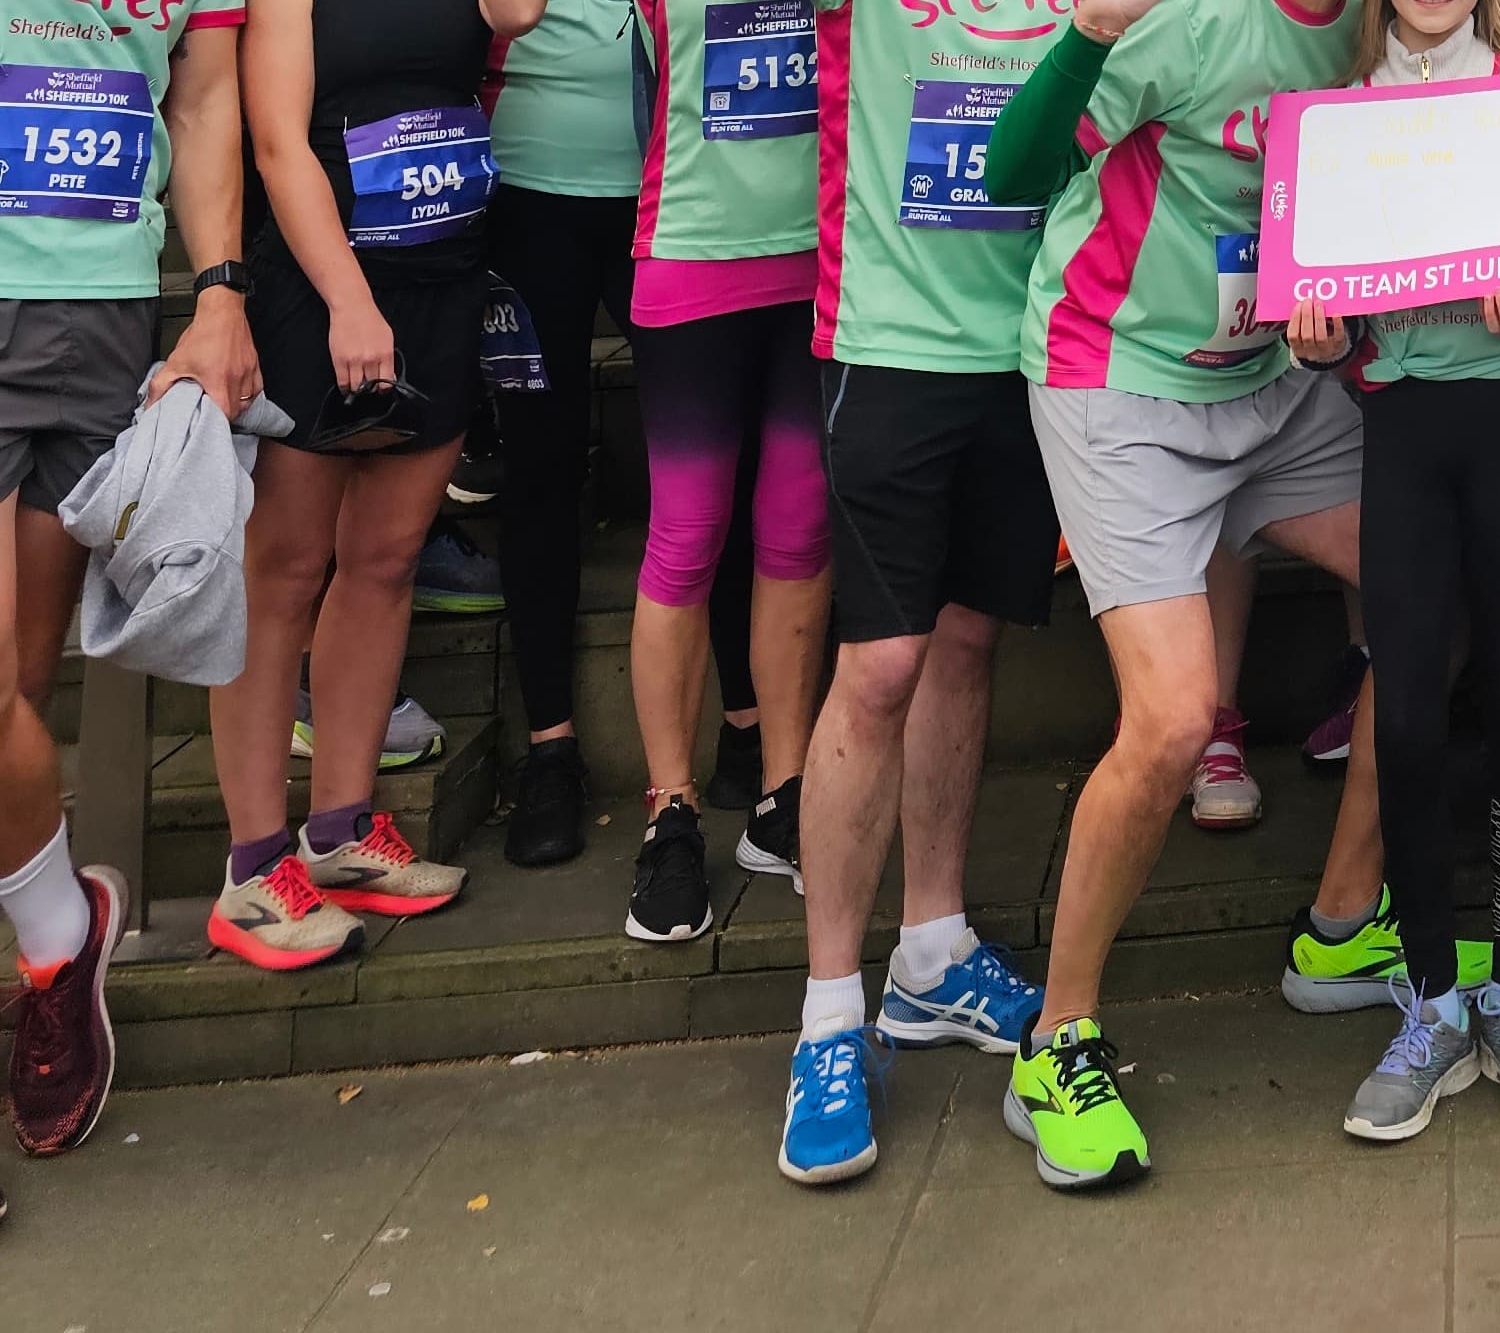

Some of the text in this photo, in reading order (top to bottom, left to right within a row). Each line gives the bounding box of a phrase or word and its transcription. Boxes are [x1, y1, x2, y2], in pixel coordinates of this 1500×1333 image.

[770, 2, 801, 11] Sheffield
[770, 9, 797, 19] Mutual
[9, 18, 106, 42] Sheffield's
[755, 19, 808, 32] SHEFFIELD
[931, 52, 1006, 71] Sheffield's
[65, 72, 102, 83] Sheffield
[64, 81, 96, 90] Mutual
[981, 88, 1014, 98] Sheffield
[46, 91, 129, 106] SHEFFIELD 10K
[412, 112, 442, 123] Sheffield
[964, 107, 1003, 118] SHEFF
[399, 127, 465, 145] SHEFFIELD 10K
[24, 126, 122, 167] 1532
[945, 143, 987, 180] 15
[48, 174, 86, 189] PETE
[401, 162, 465, 201] 504
[411, 202, 450, 220] LYDIA
[908, 211, 952, 222] RUN FOR ALL
[1294, 277, 1337, 302] GO
[1344, 270, 1417, 299] TEAM
[1423, 263, 1455, 289] ST
